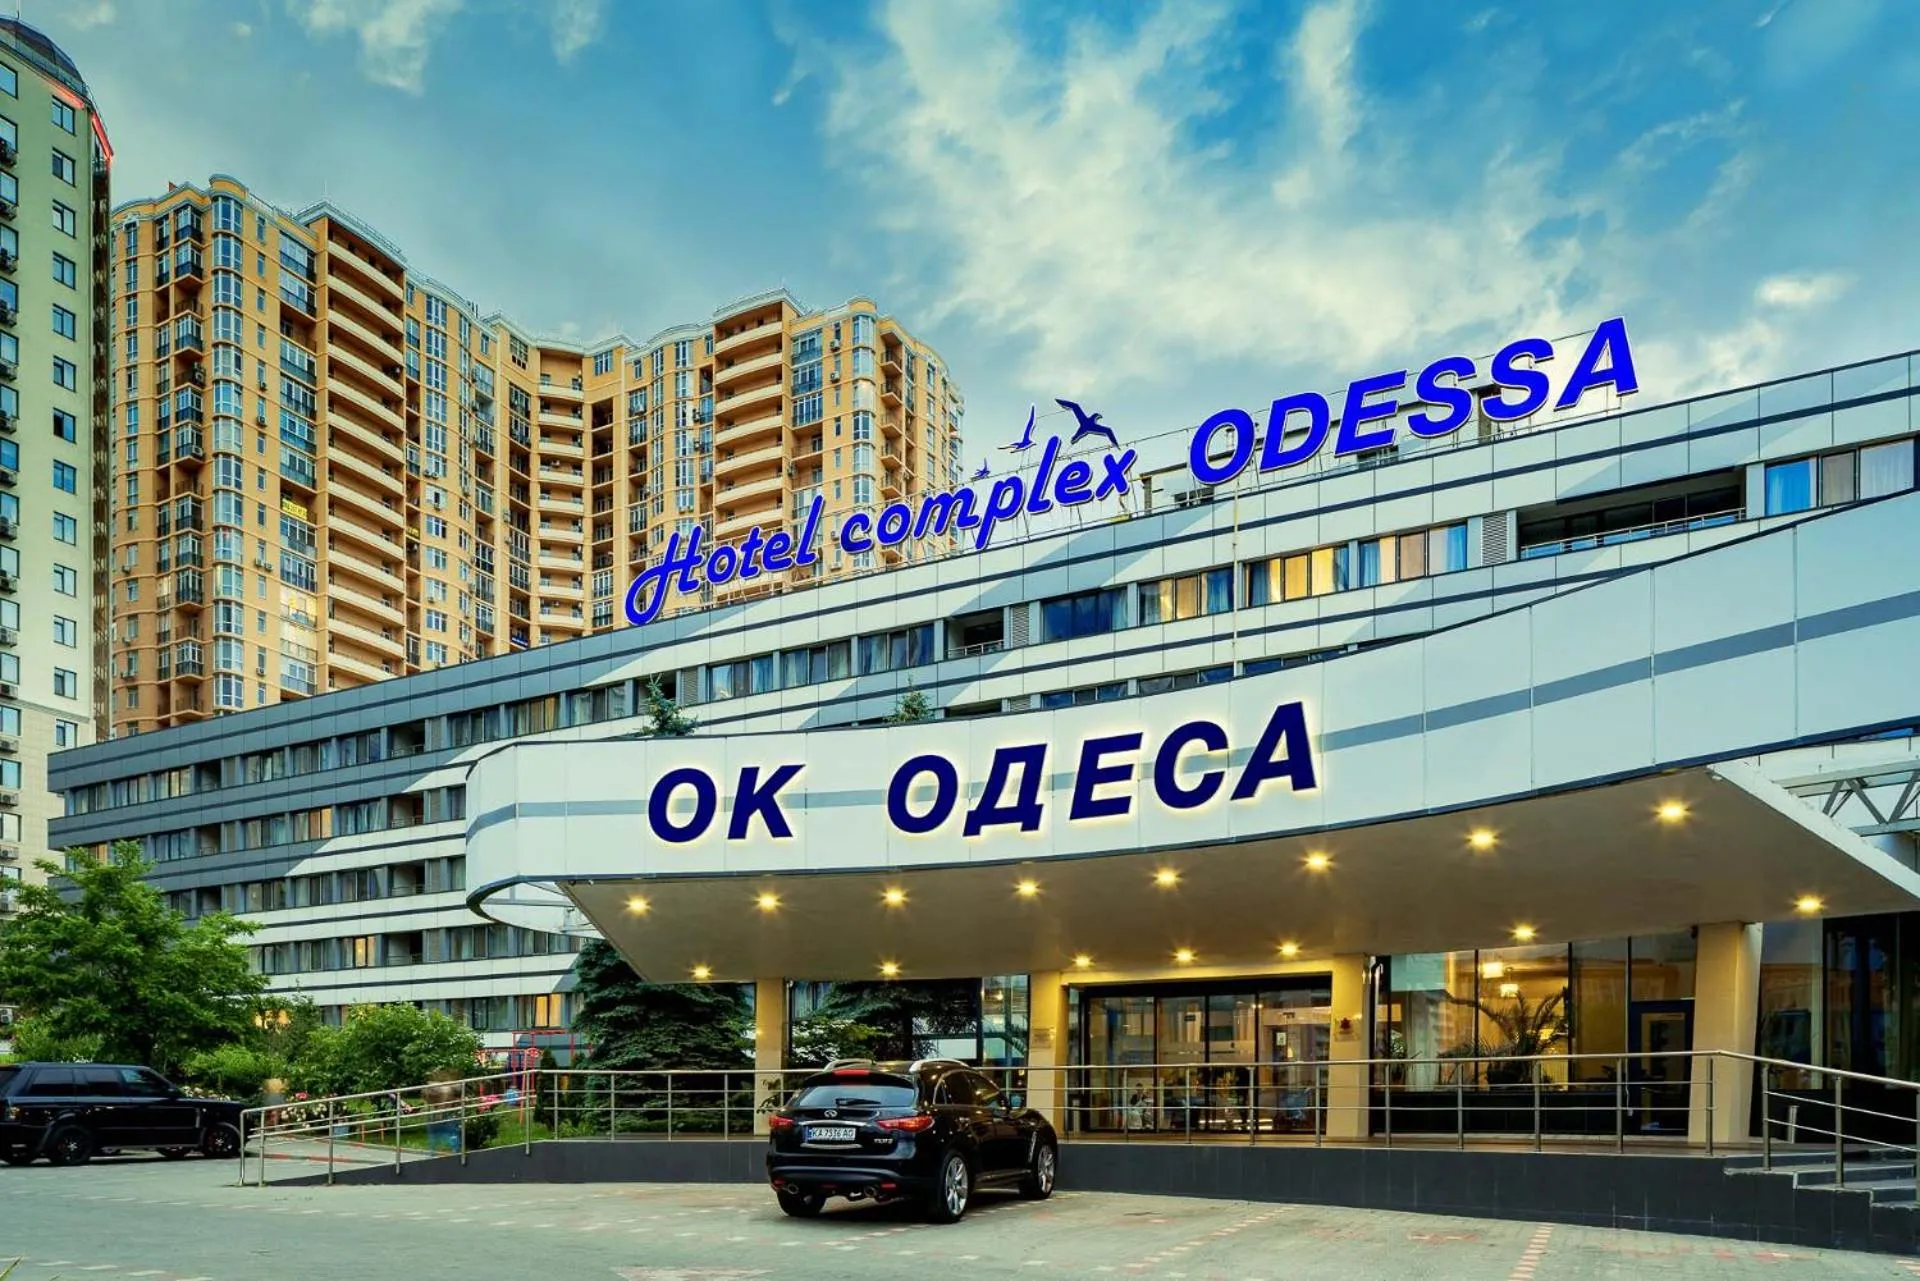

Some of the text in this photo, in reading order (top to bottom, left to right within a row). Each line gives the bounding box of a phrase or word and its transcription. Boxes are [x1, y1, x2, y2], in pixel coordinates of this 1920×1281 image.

[624, 316, 1640, 627] Hotel complex ODESSA
[647, 701, 1317, 843] ОК ОДЕСА
